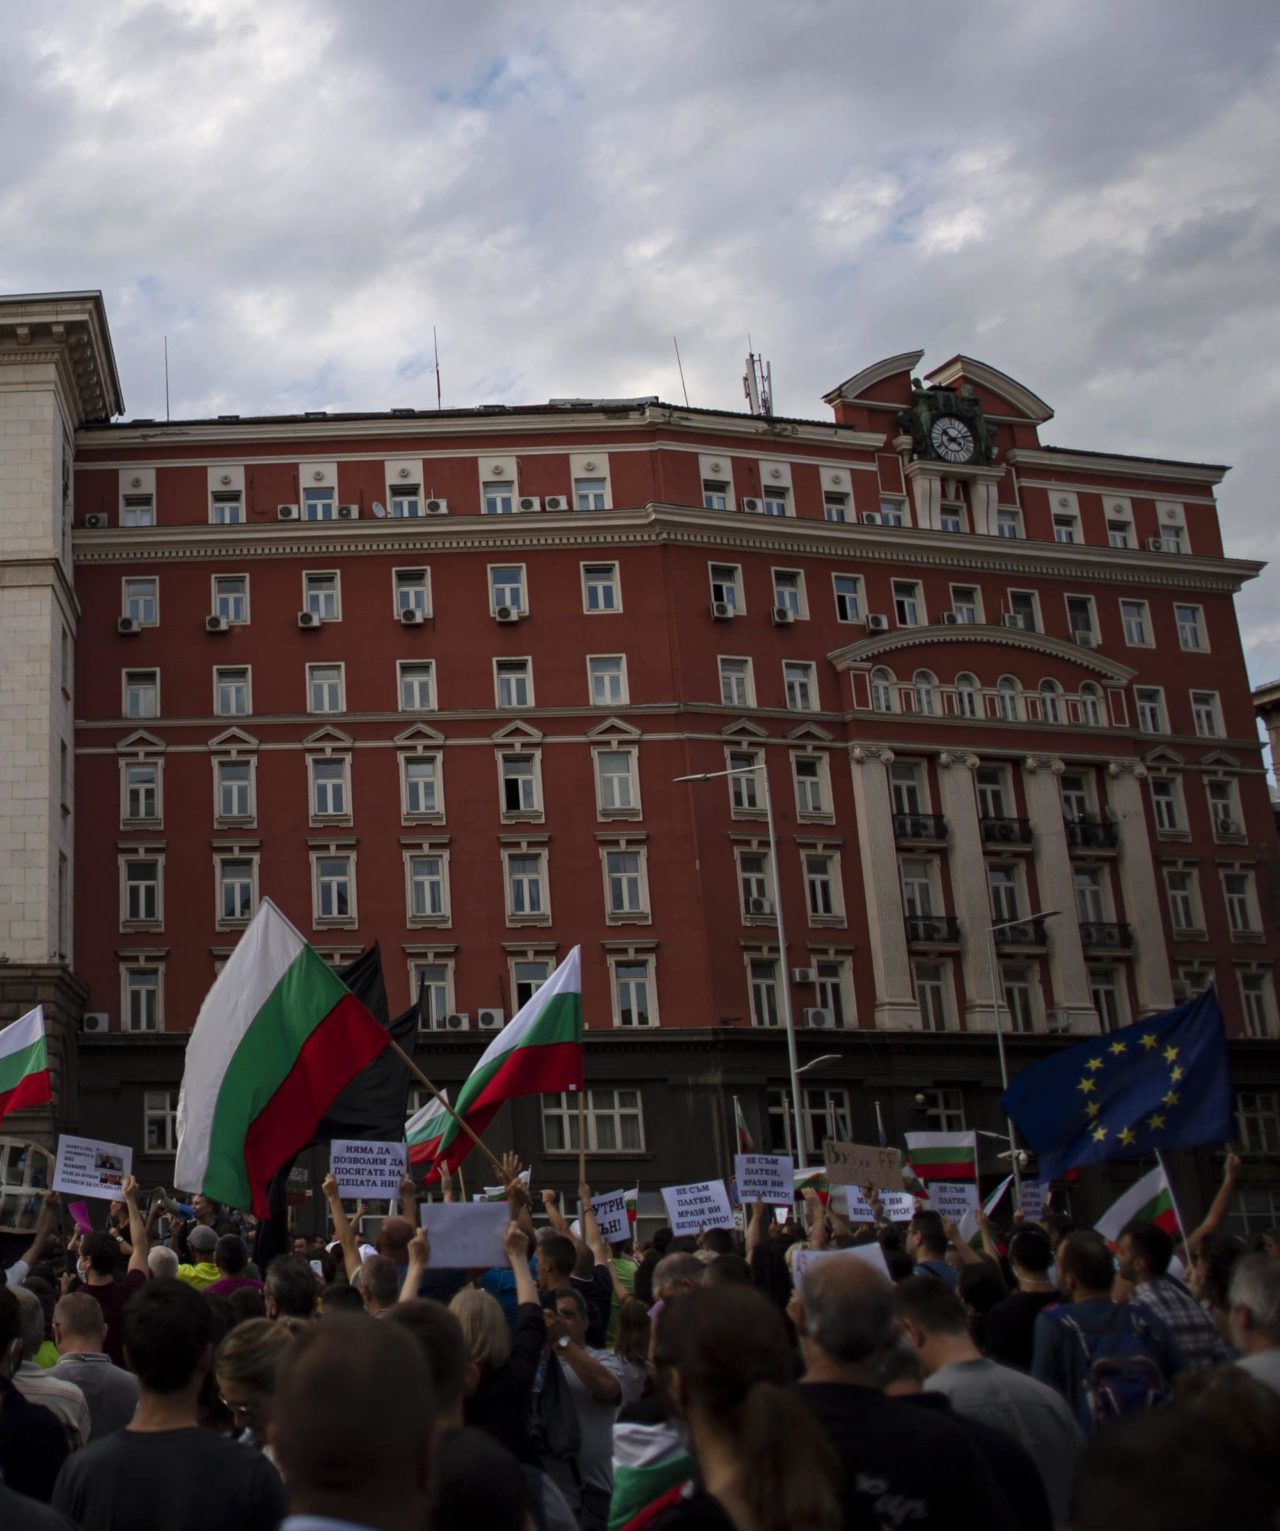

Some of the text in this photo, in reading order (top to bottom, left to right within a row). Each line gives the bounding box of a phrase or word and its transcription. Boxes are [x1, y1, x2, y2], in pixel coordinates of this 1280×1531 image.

[346, 1145, 391, 1155] НЯМА ДА
[333, 1156, 404, 1167] ПОЗВОЛИМ ДА
[758, 1157, 778, 1165] СЪМ
[334, 1167, 402, 1177] ПОСЯГАТЕ НА
[338, 1178, 398, 1188] ДЕЦАТА НИ!
[676, 1185, 710, 1195] НЕ СЪМ
[592, 1197, 624, 1216] УТРИ
[677, 1205, 721, 1218] МРАЗЯ ВИ
[598, 1218, 622, 1235] ЪН!
